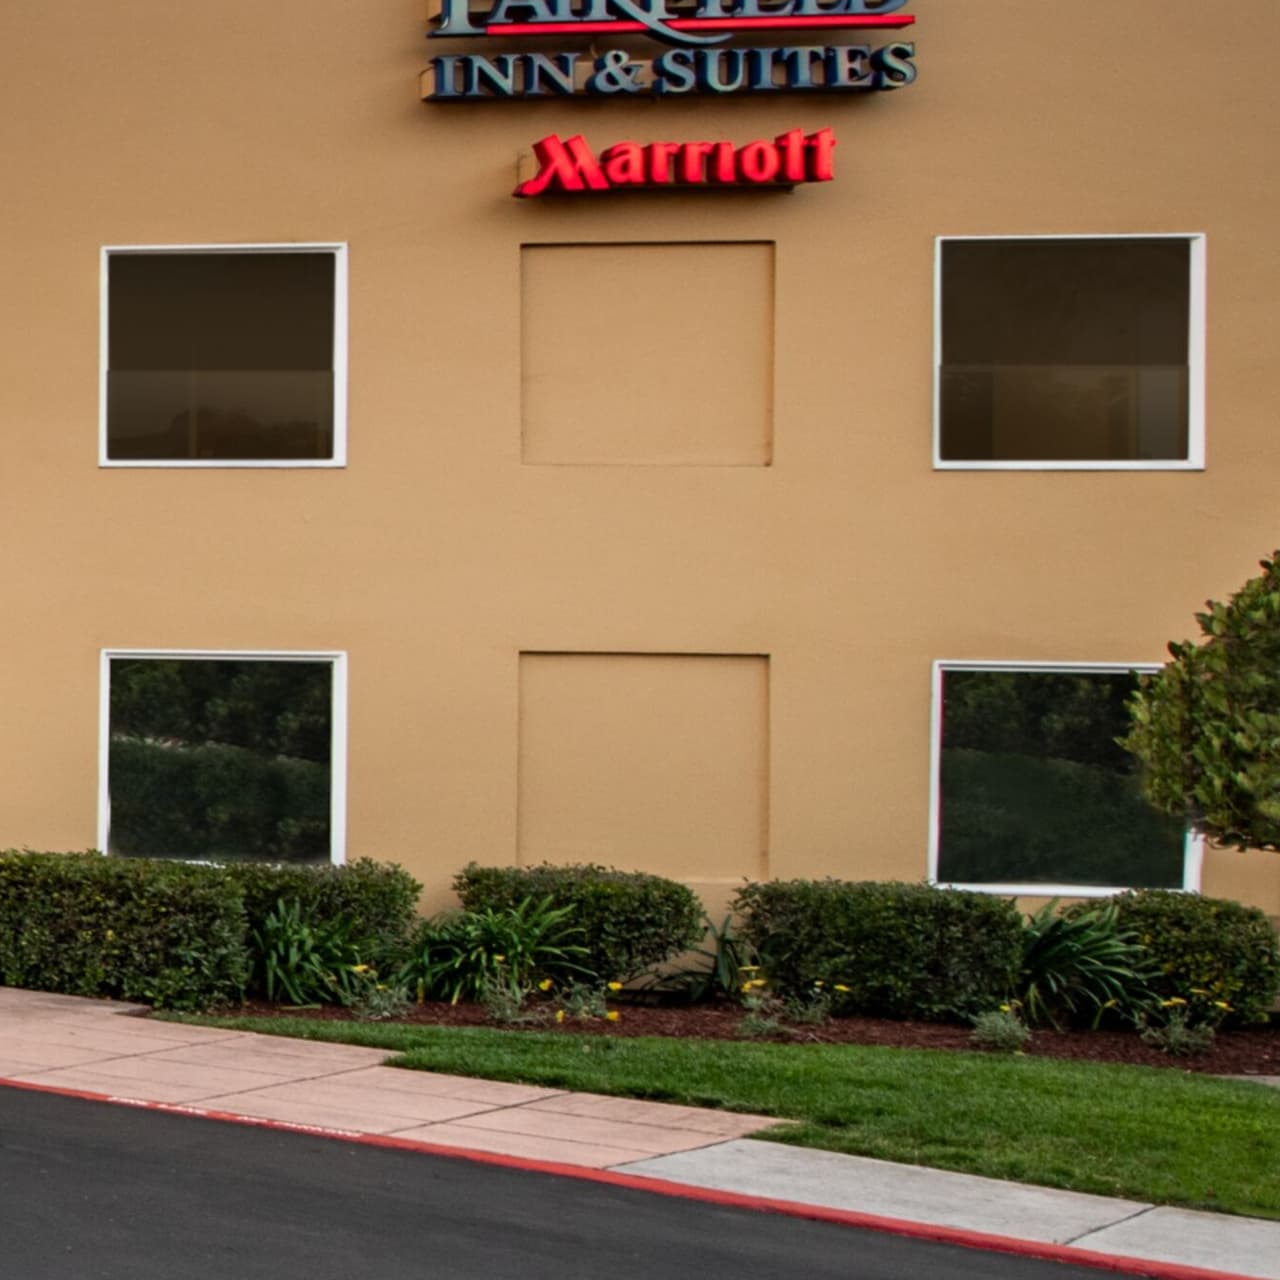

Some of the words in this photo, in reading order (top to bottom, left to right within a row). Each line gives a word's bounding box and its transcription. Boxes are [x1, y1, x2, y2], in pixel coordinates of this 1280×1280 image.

[430, 51, 582, 100] INN
[587, 49, 644, 95] &
[654, 42, 917, 97] SUITES
[513, 127, 836, 198] Marriott
